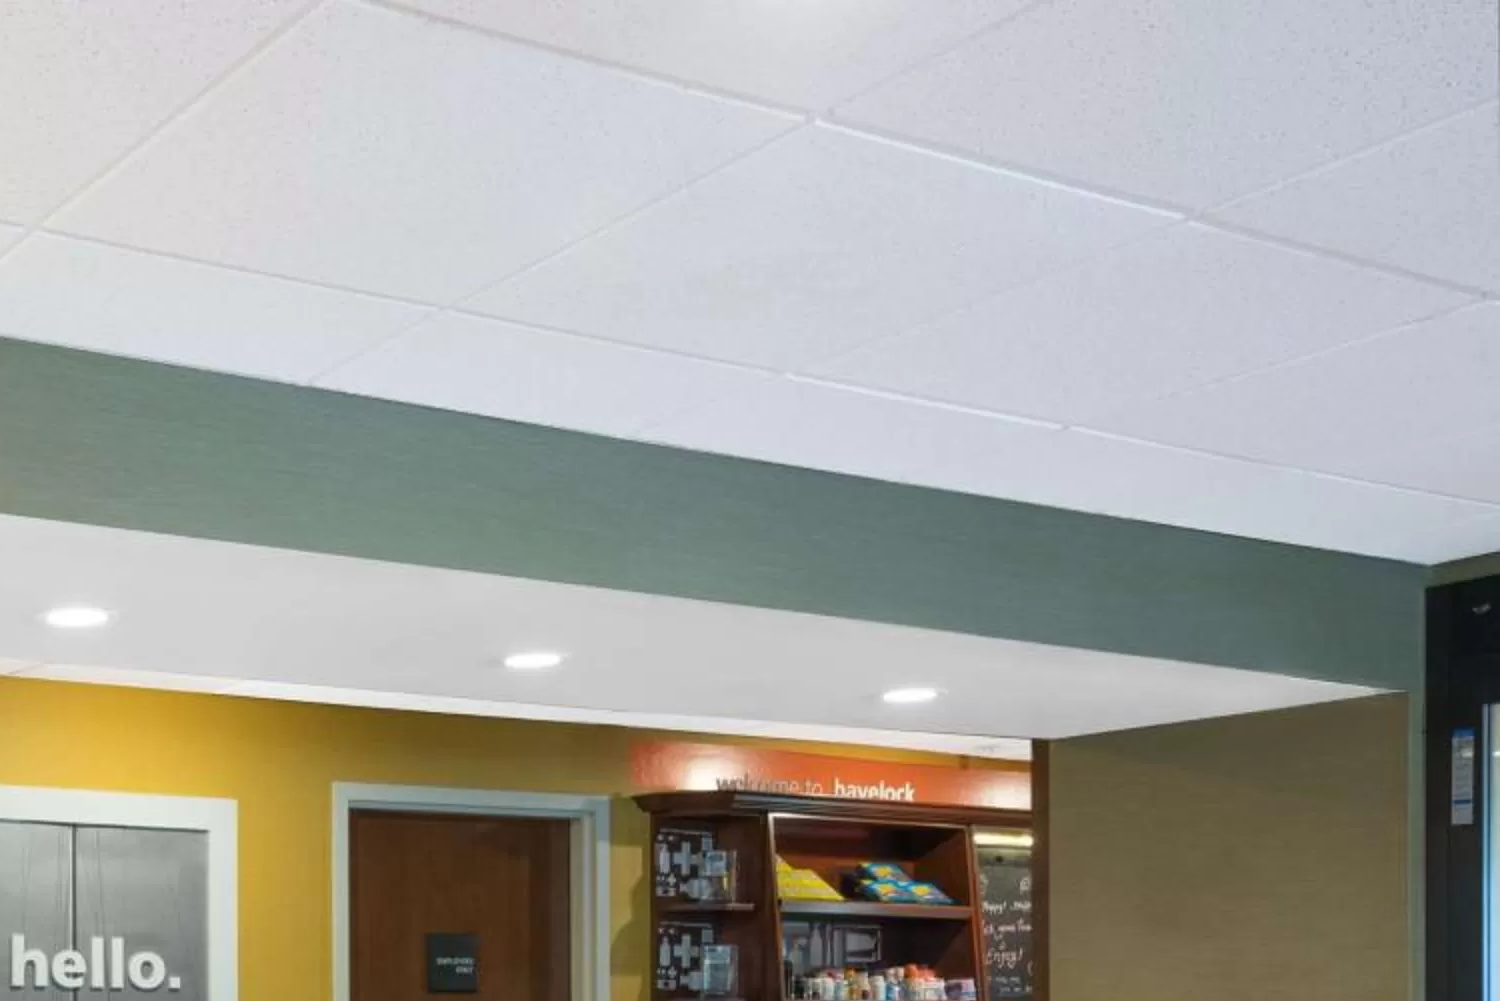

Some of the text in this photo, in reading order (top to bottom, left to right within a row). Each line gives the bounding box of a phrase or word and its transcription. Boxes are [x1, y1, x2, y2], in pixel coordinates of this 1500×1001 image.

[805, 775, 823, 795] to
[834, 776, 916, 802] havelock
[10, 932, 181, 990] hello.
